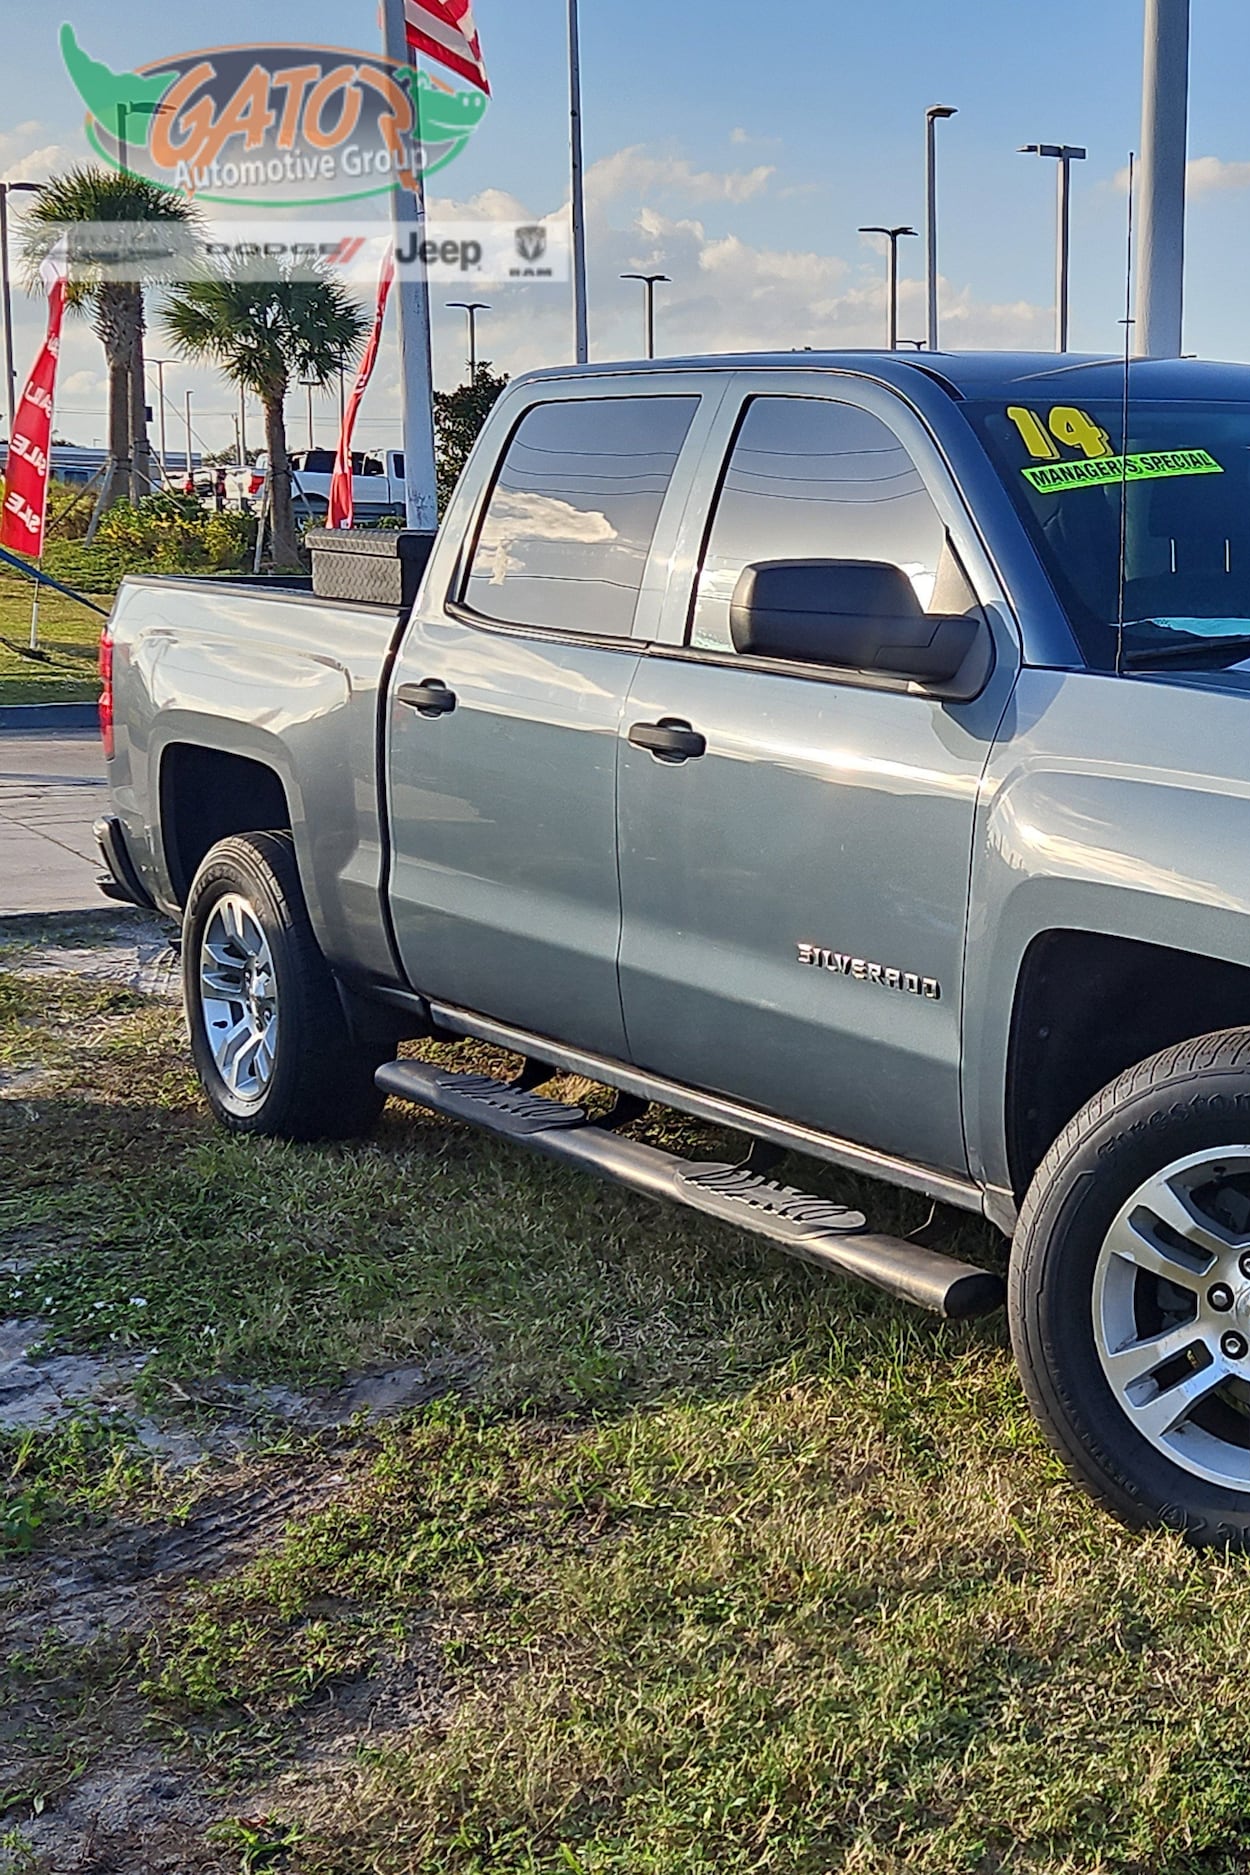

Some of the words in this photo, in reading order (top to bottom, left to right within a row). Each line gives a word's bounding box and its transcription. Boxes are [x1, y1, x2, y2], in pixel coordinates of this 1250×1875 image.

[1007, 406, 1114, 460] 14
[1139, 451, 1214, 472] SPECIAL
[797, 943, 942, 1001] SILVERADO
